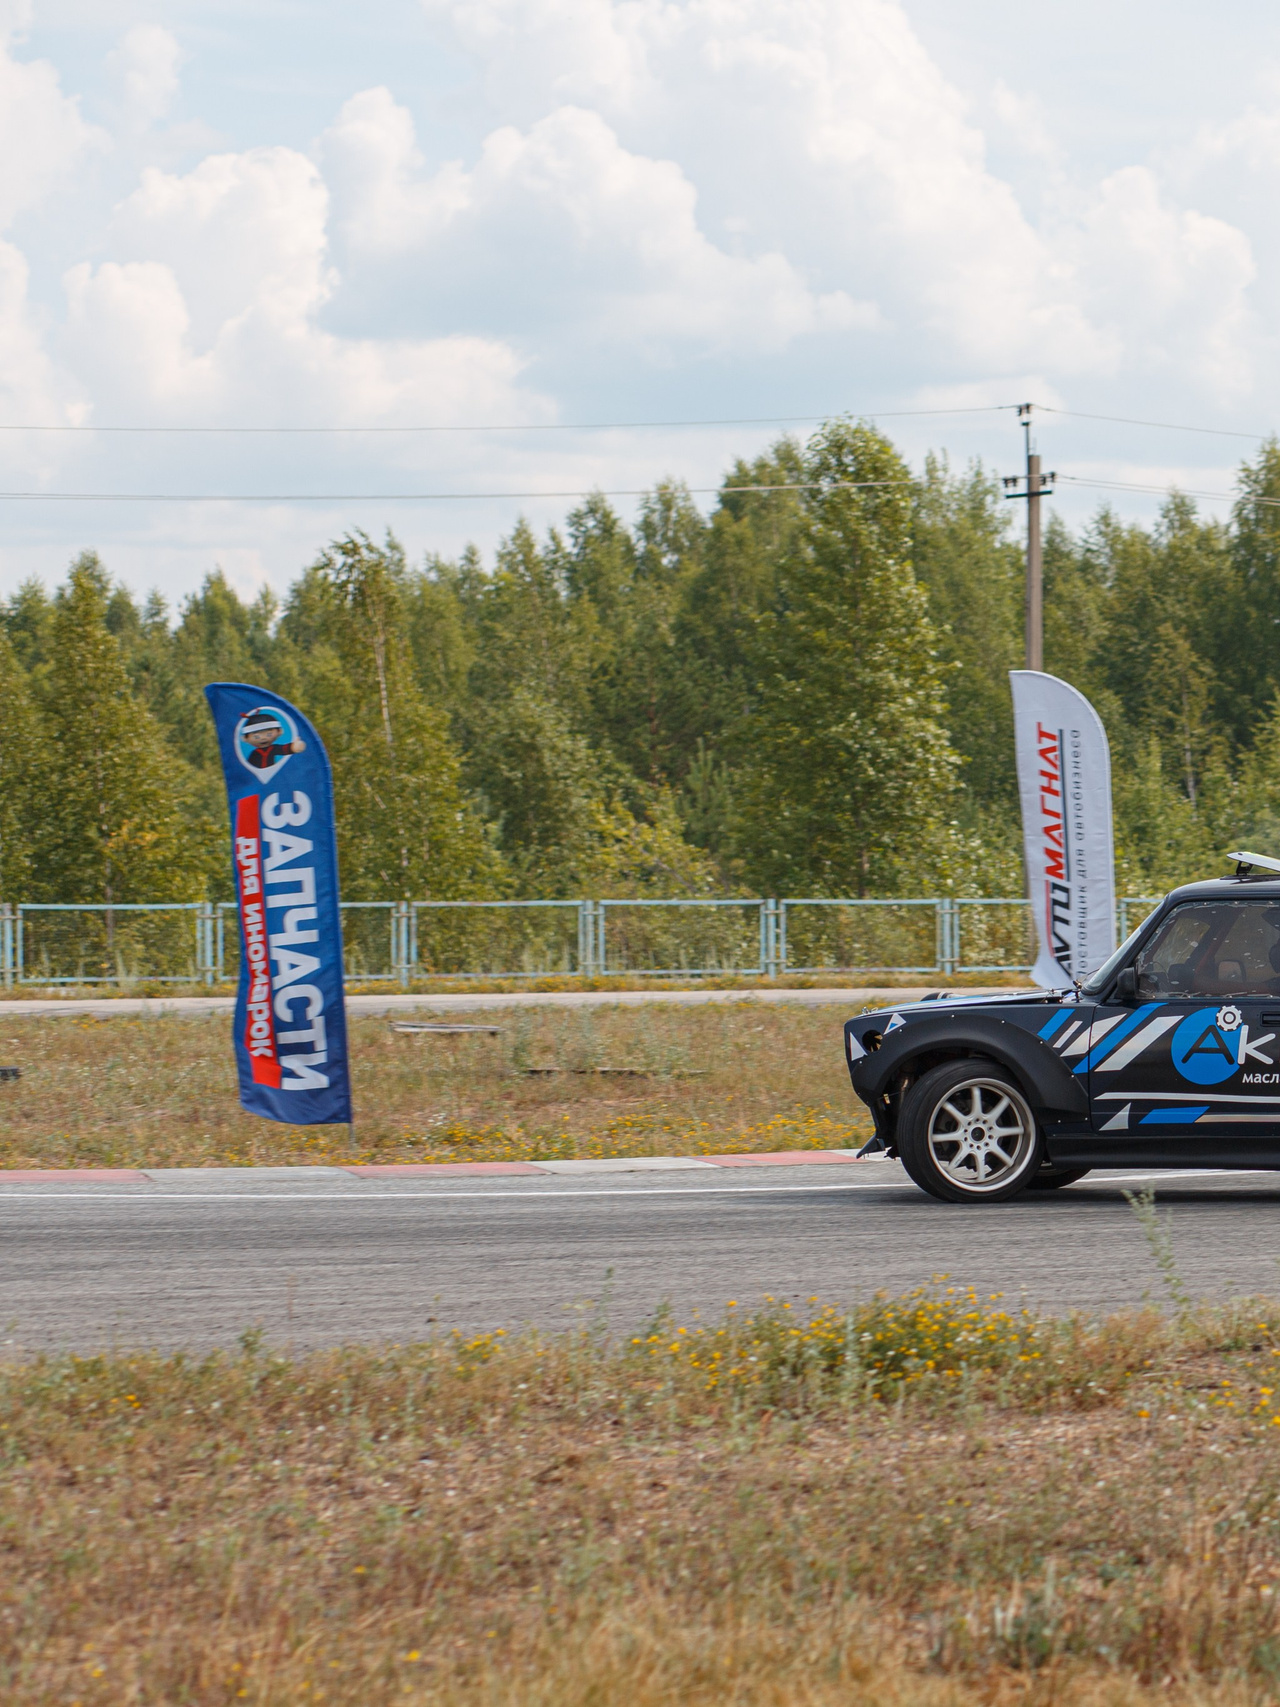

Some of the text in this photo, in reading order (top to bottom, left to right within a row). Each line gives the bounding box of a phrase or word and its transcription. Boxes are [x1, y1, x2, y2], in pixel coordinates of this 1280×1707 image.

[236, 836, 274, 1058] для иномарок
[261, 790, 330, 1091] ЗАПЧАСТИ
[1076, 848, 1088, 880] для
